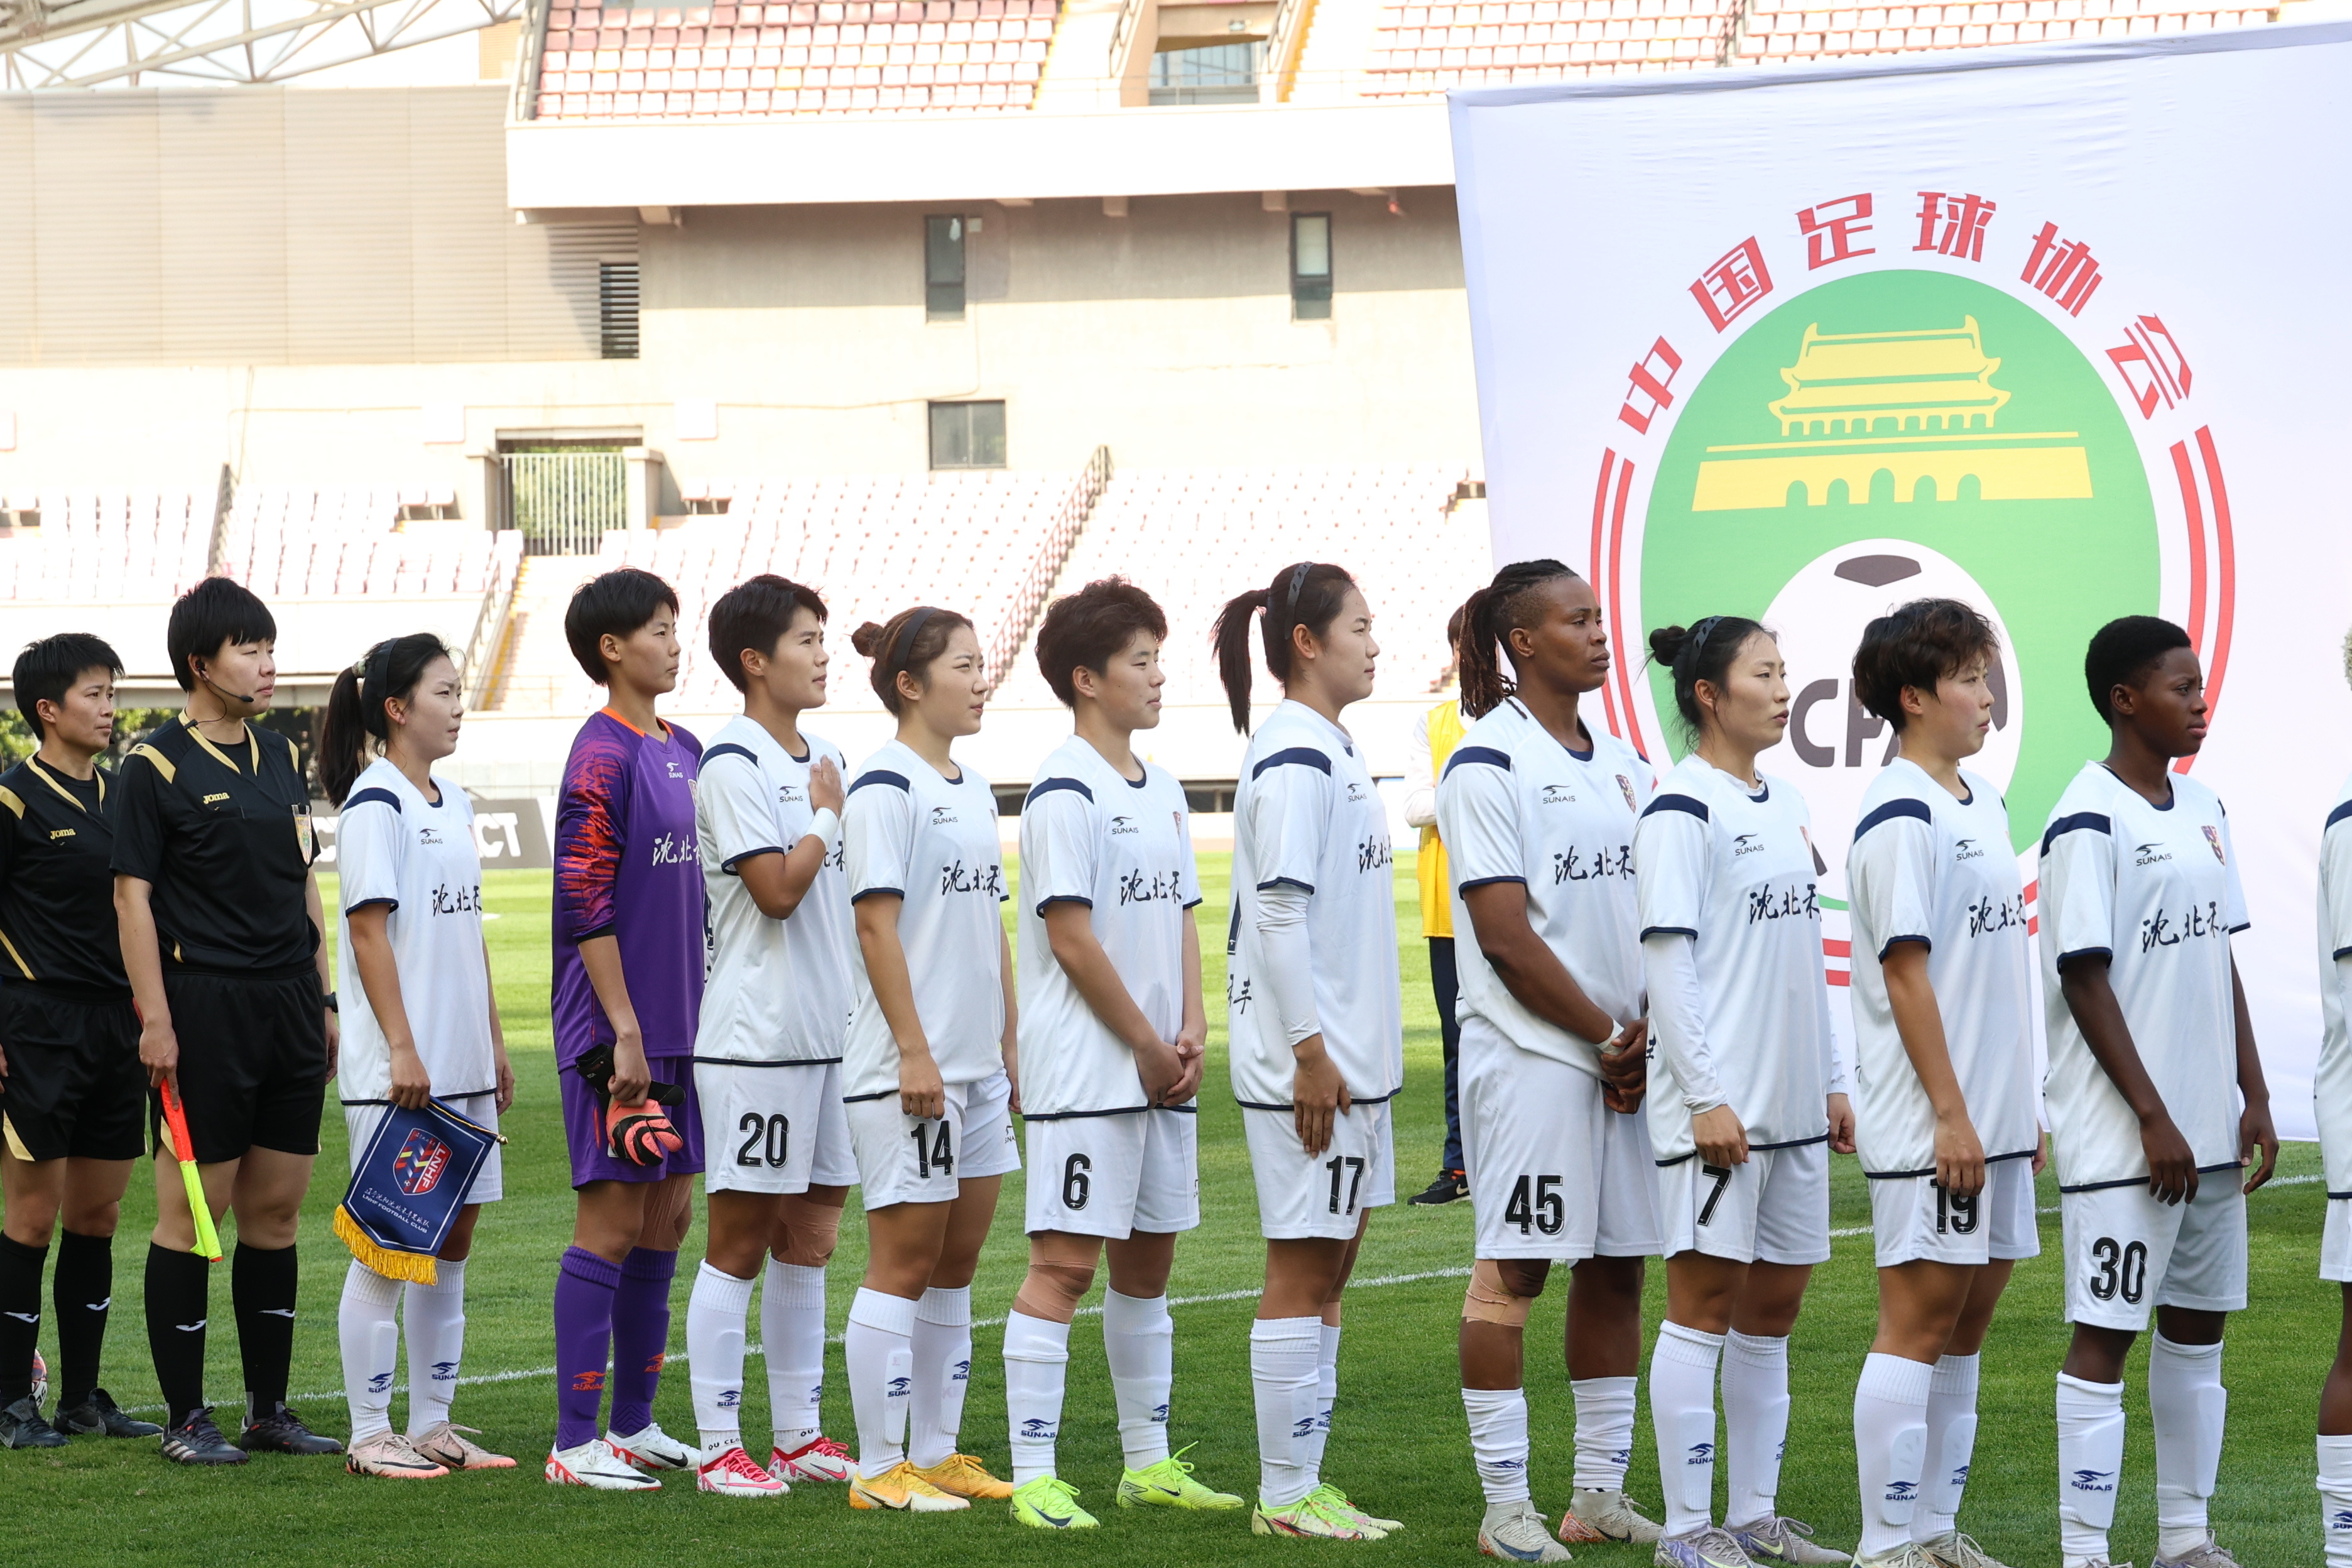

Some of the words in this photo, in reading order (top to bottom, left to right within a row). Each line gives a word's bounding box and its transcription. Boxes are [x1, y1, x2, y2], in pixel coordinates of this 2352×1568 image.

[1617, 191, 2192, 435] 中国足球协会
[933, 817, 958, 825] SUNAIS
[1543, 795, 1576, 804] SUNAIS
[1735, 844, 1764, 856] SUNAIS
[1956, 849, 1984, 861] SUNAIS
[2136, 853, 2172, 866] SUNAIS
[1750, 883, 1822, 925] 沈北禾
[2142, 901, 2229, 954] 沈北禾
[737, 1112, 790, 1169] 20
[910, 1120, 954, 1179] 14
[422, 1148, 446, 1188] LNHF
[1062, 1153, 1092, 1210] 6
[1326, 1155, 1366, 1215] 17
[378, 1202, 409, 1223] FOOTBALL
[410, 1222, 427, 1233] CLUB
[1505, 1175, 1565, 1235] 45
[1696, 1165, 1733, 1226] 7
[1930, 1178, 1980, 1234] 19
[2089, 1236, 2148, 1304] 30
[1021, 1430, 1056, 1438] SUNAIS
[2071, 1480, 2113, 1491] SUNAIS
